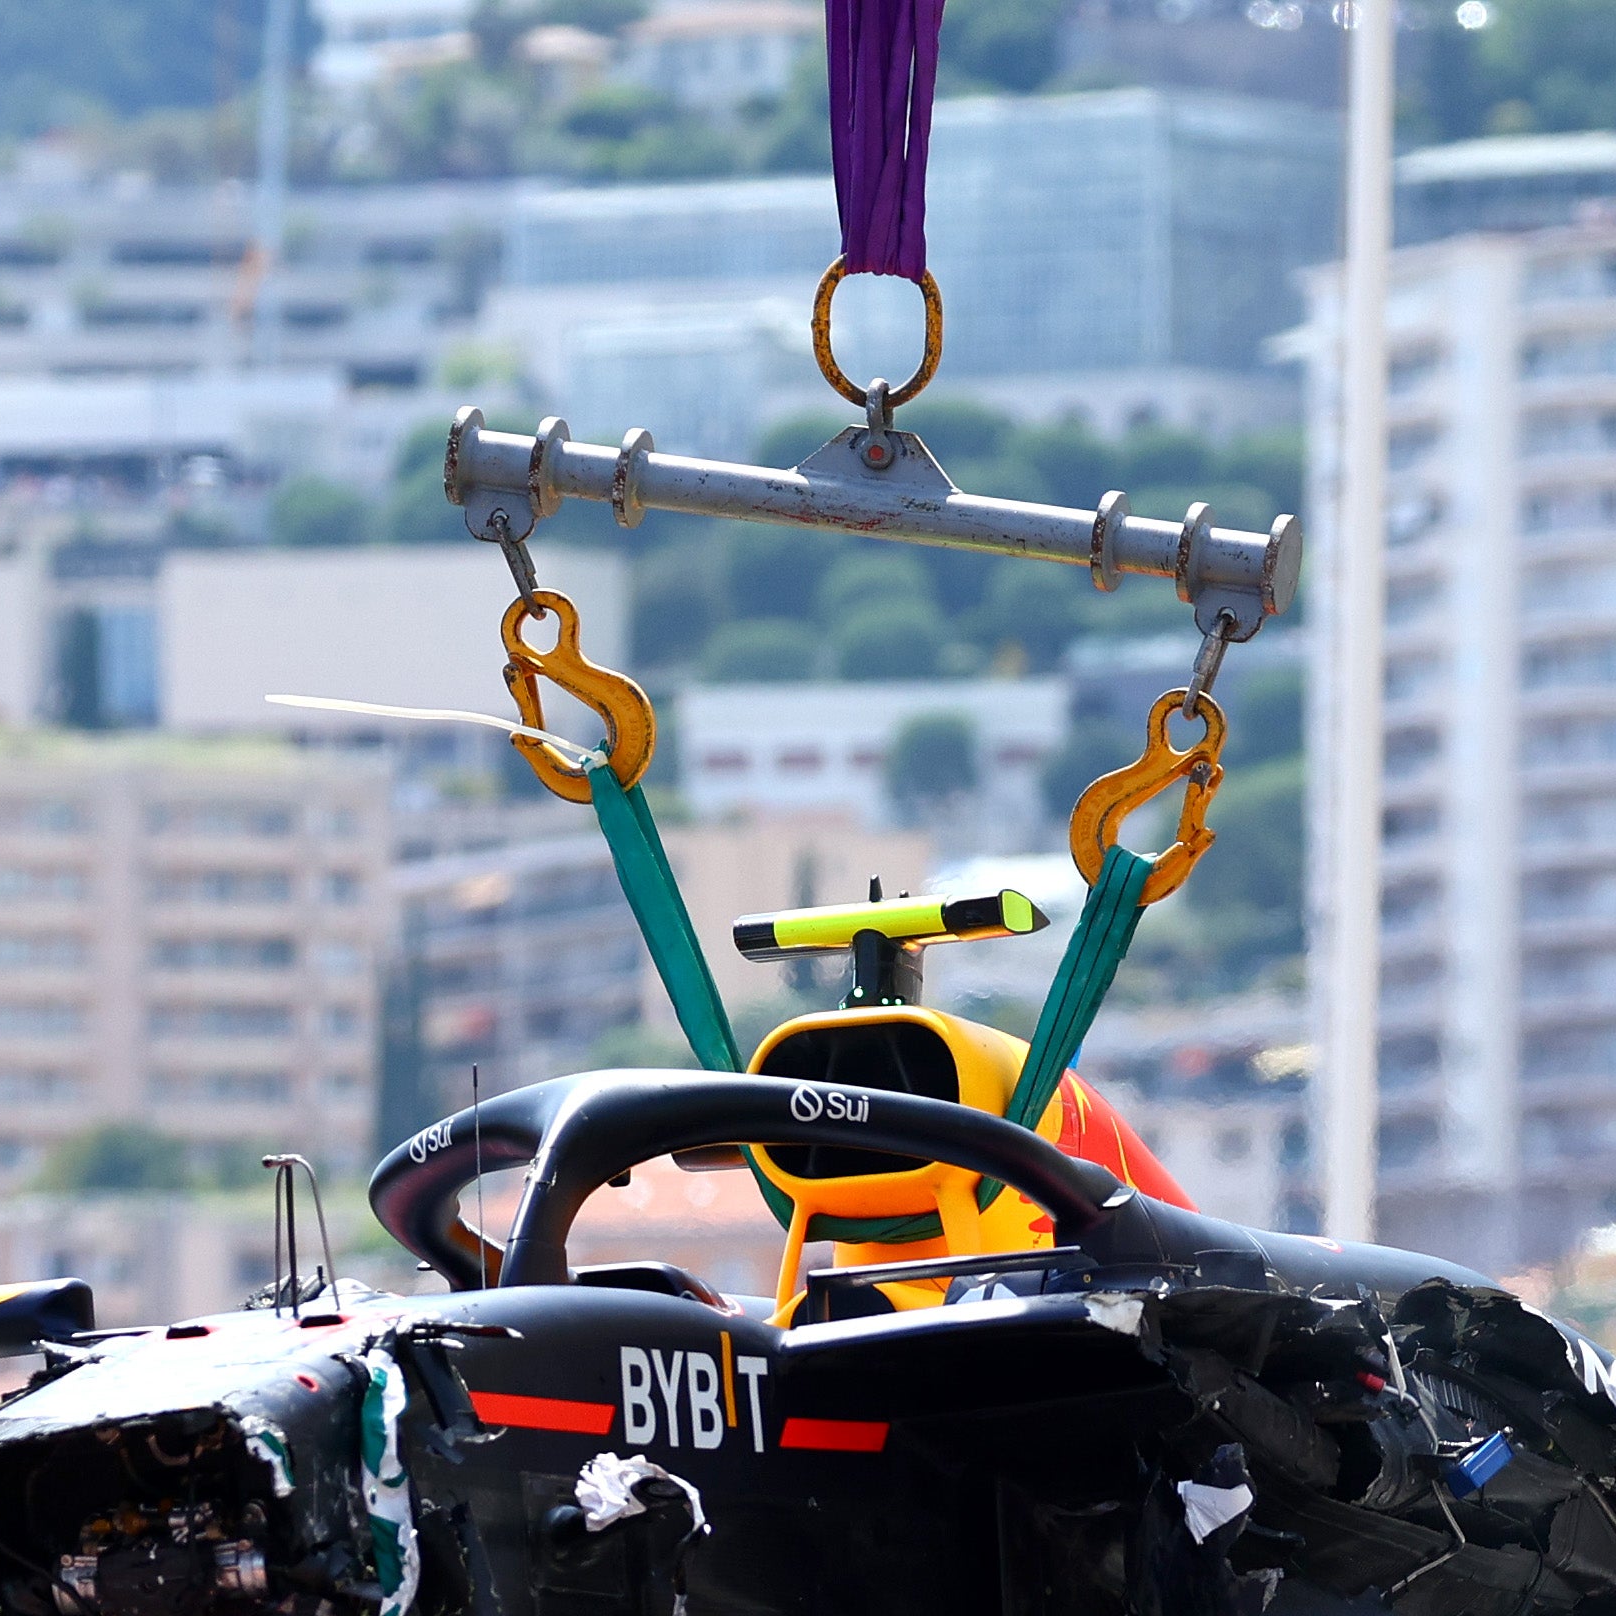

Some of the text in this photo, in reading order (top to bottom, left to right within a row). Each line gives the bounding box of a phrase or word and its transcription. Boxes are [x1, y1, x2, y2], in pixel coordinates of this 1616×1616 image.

[826, 1090, 870, 1123] Sui
[427, 1119, 454, 1152] Sui
[620, 1330, 769, 1453] BYBIT
